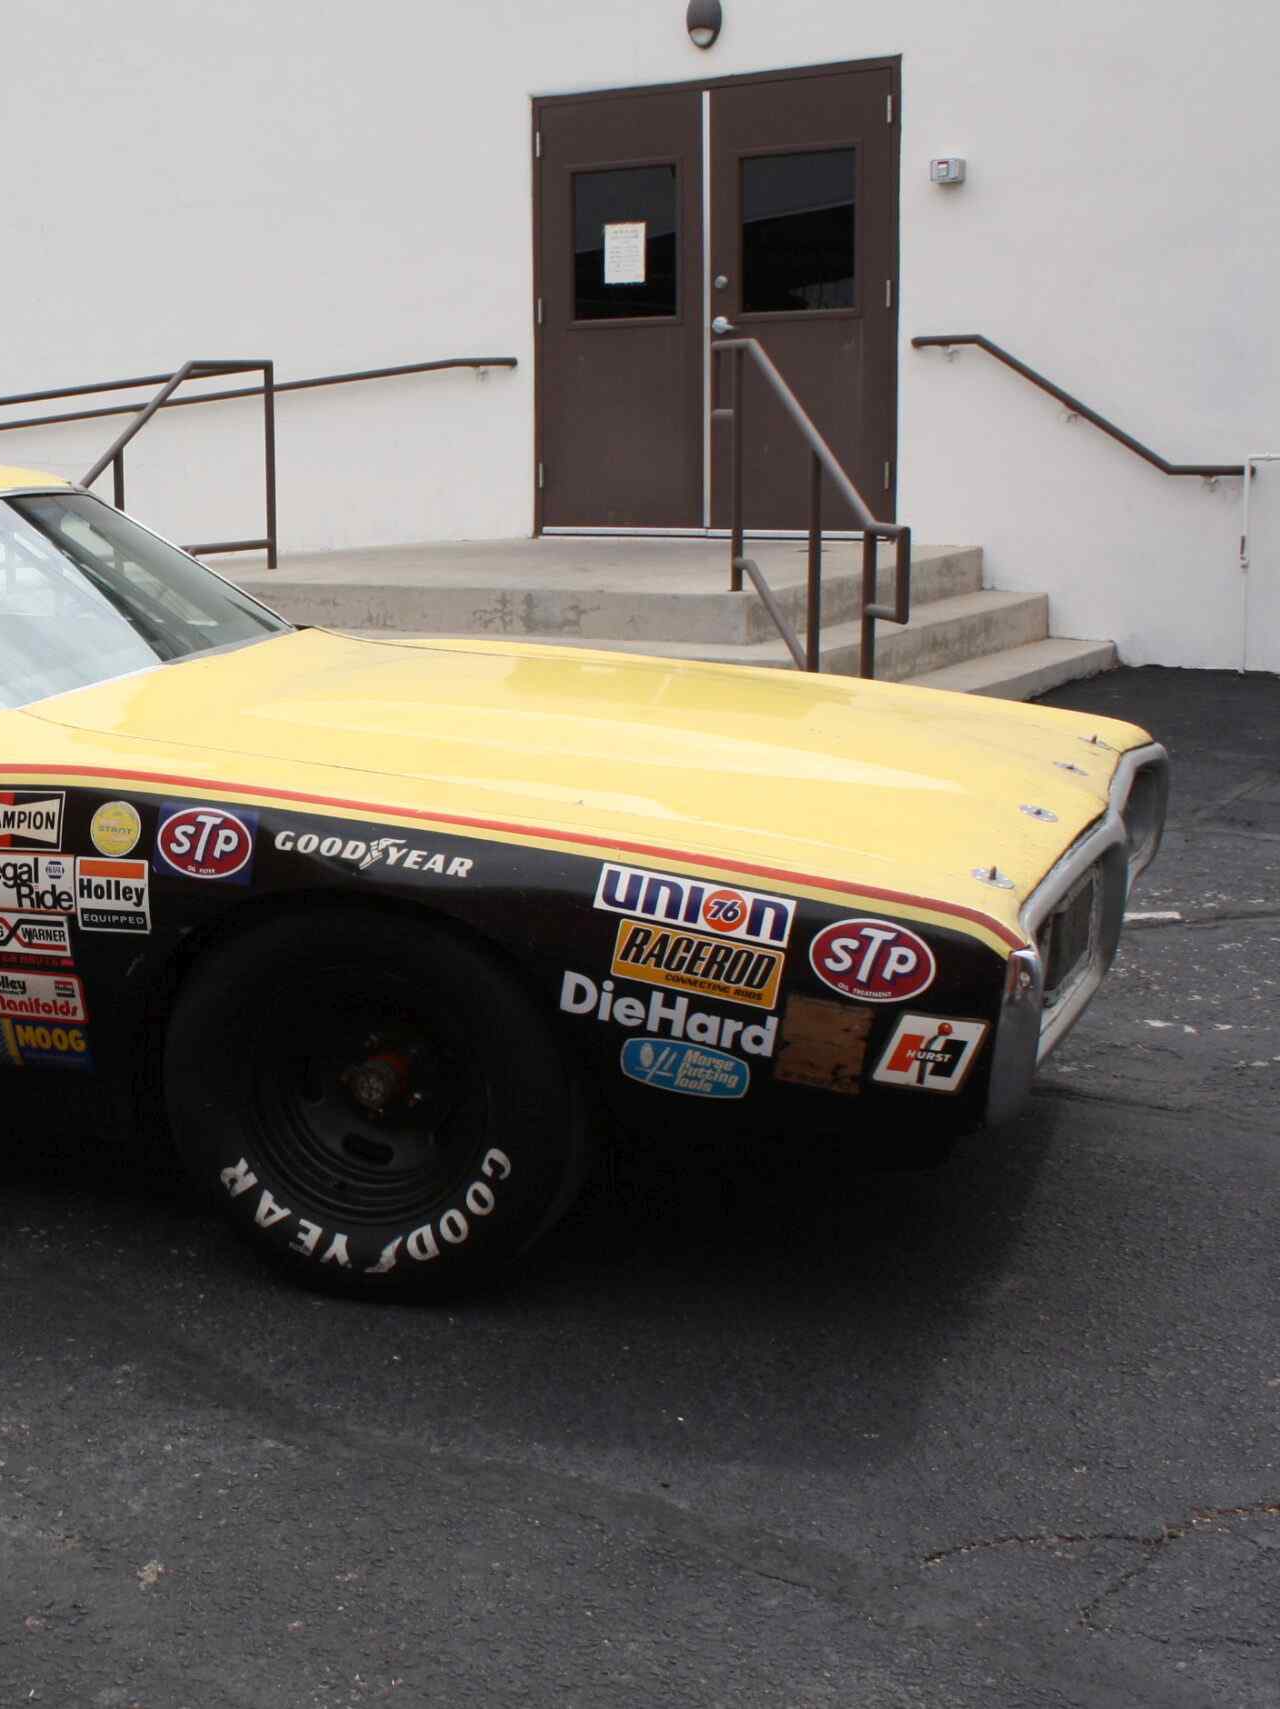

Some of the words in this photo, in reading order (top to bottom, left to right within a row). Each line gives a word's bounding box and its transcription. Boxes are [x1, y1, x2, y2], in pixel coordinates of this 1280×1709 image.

[169, 814, 239, 862] STP
[16, 882, 74, 911] Ride
[78, 877, 145, 908] Holley
[83, 913, 144, 925] EQUIPPED
[709, 901, 740, 922] 76
[20, 927, 67, 943] WARNER
[620, 927, 778, 990] RACEROD
[823, 928, 918, 985] STP
[559, 970, 779, 1058] DieHard
[15, 1024, 87, 1053] MOOG
[906, 1049, 952, 1062] HURST
